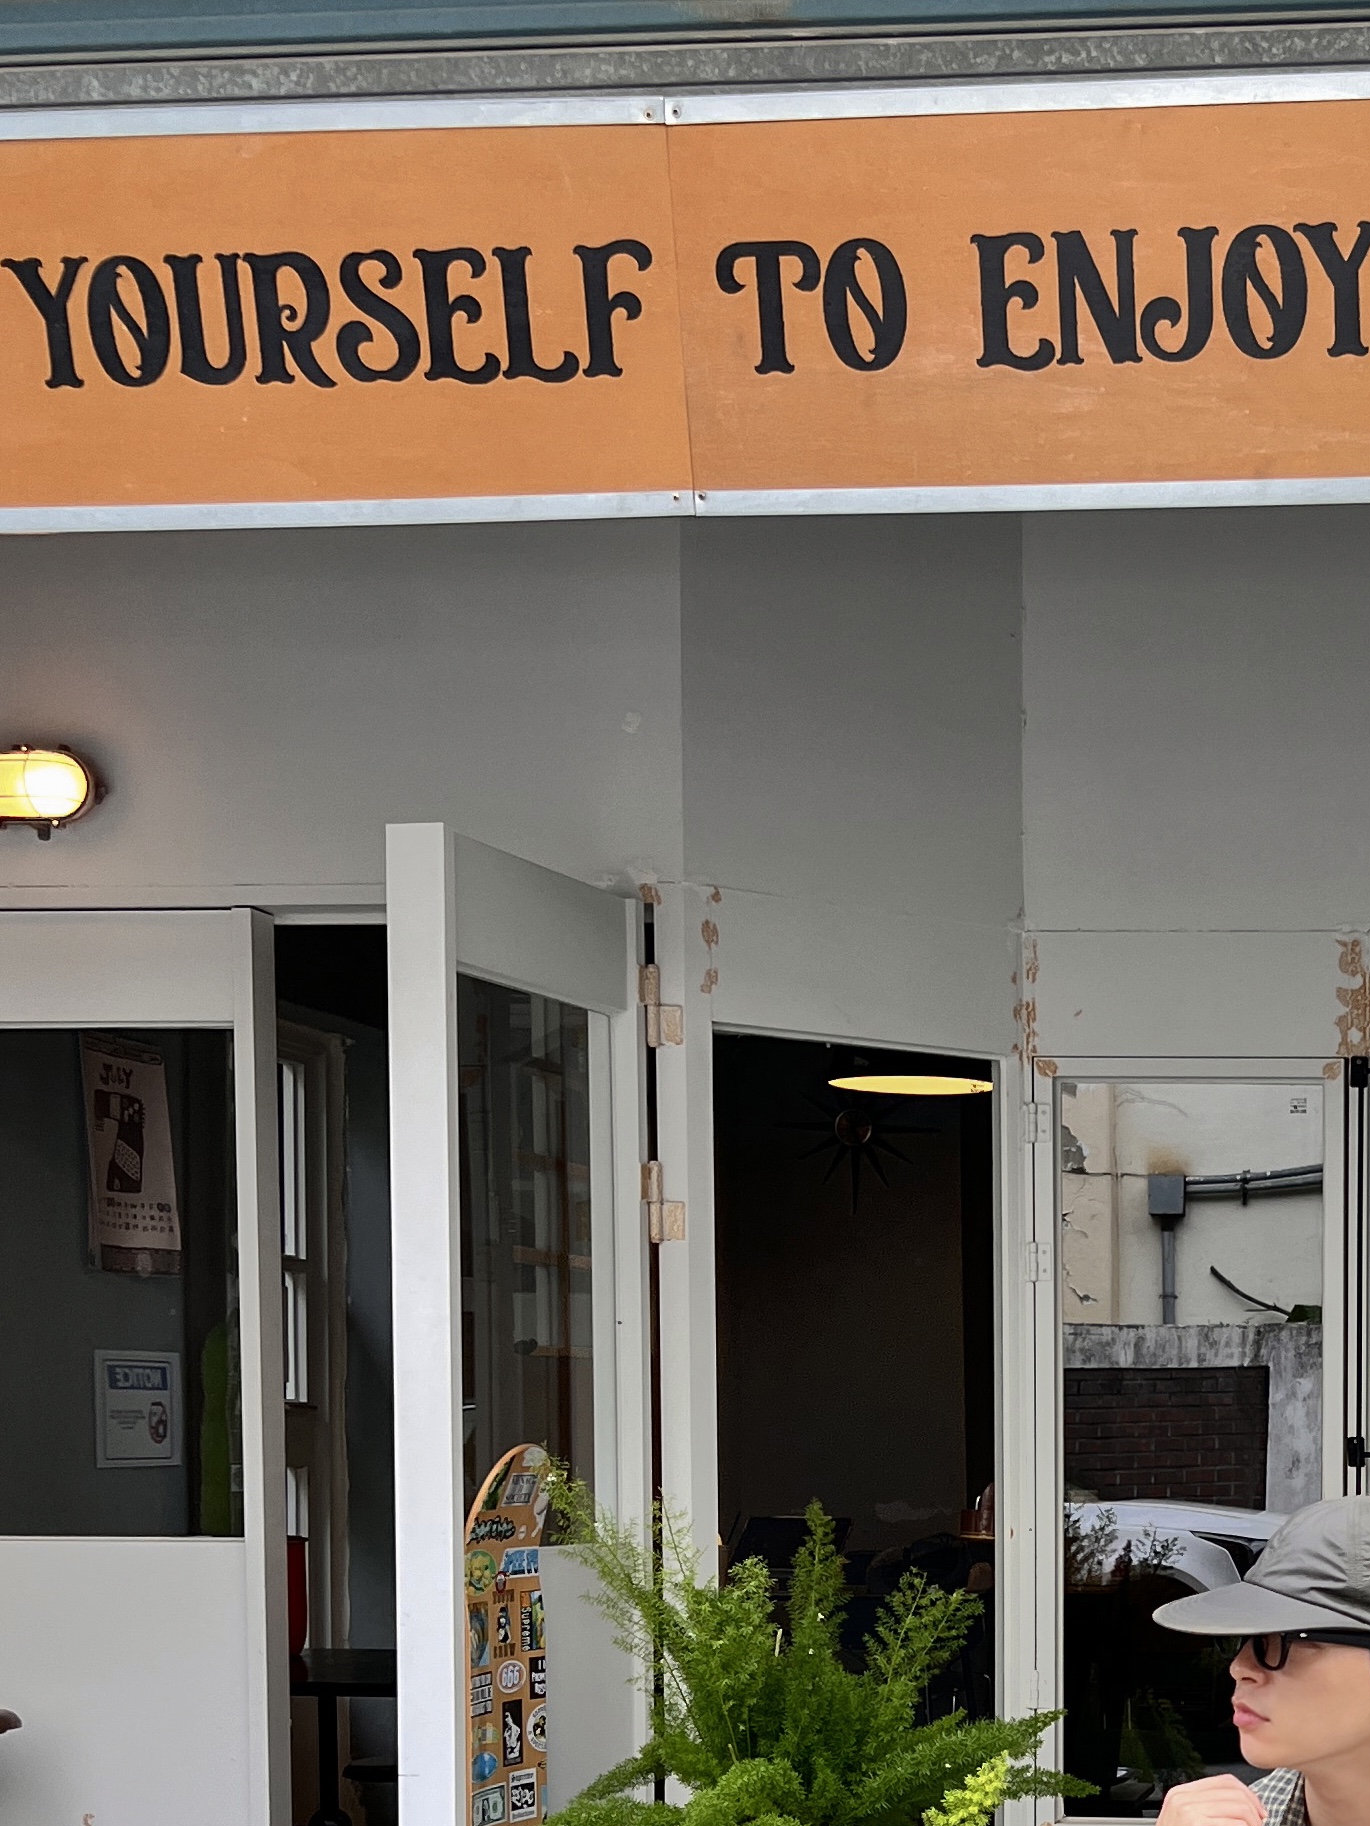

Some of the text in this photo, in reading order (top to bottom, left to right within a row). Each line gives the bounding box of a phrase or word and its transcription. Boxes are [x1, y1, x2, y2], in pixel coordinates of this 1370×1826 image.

[1, 238, 653, 390] YOURSELF
[715, 237, 908, 375] TO
[521, 1607, 532, 1652] Supreme
[502, 1667, 520, 1688] 666
